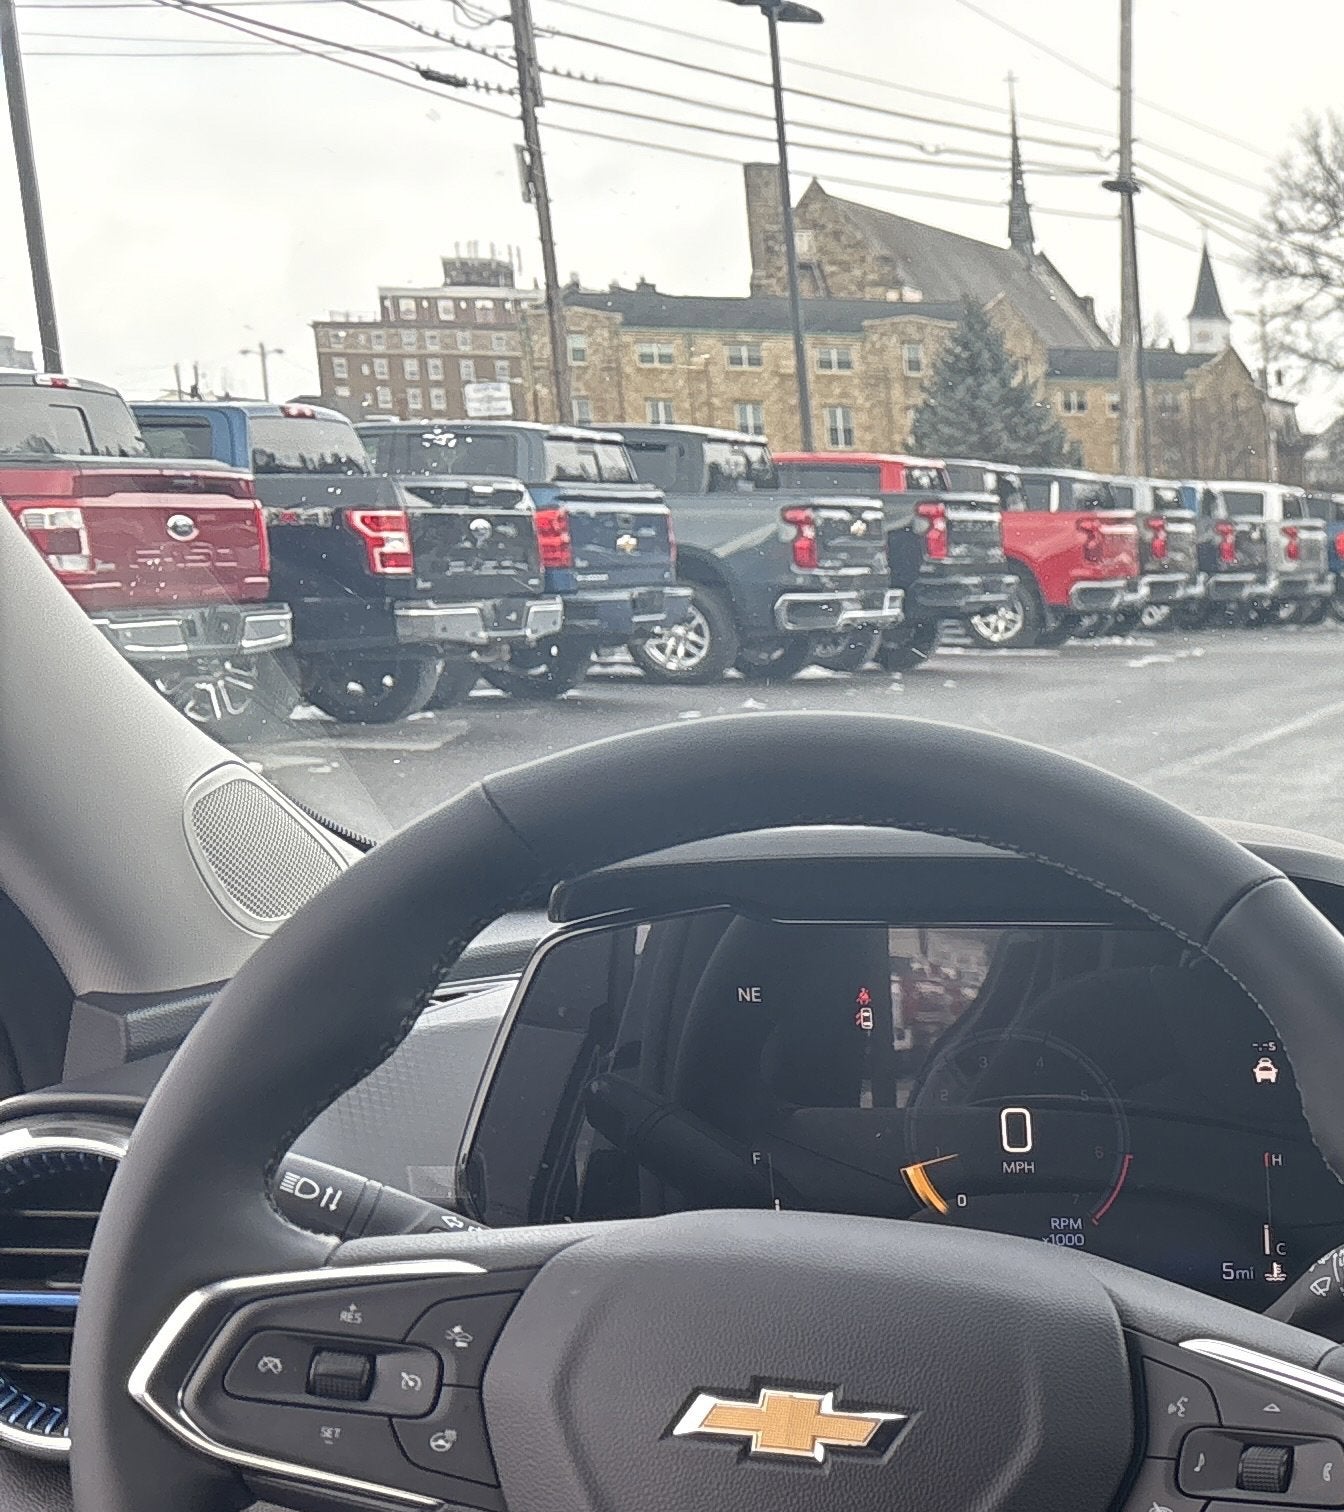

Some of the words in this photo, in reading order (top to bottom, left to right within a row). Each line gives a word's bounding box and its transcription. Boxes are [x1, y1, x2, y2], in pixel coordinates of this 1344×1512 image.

[737, 987, 762, 1002] NE
[979, 1056, 989, 1068] 3
[1001, 1107, 1032, 1153] 0
[752, 1152, 761, 1165] F
[1271, 1154, 1283, 1166] H
[1002, 1162, 1035, 1174] MPH
[957, 1194, 967, 1207] 0
[1050, 1218, 1083, 1230] RPM
[1276, 1242, 1287, 1256] C
